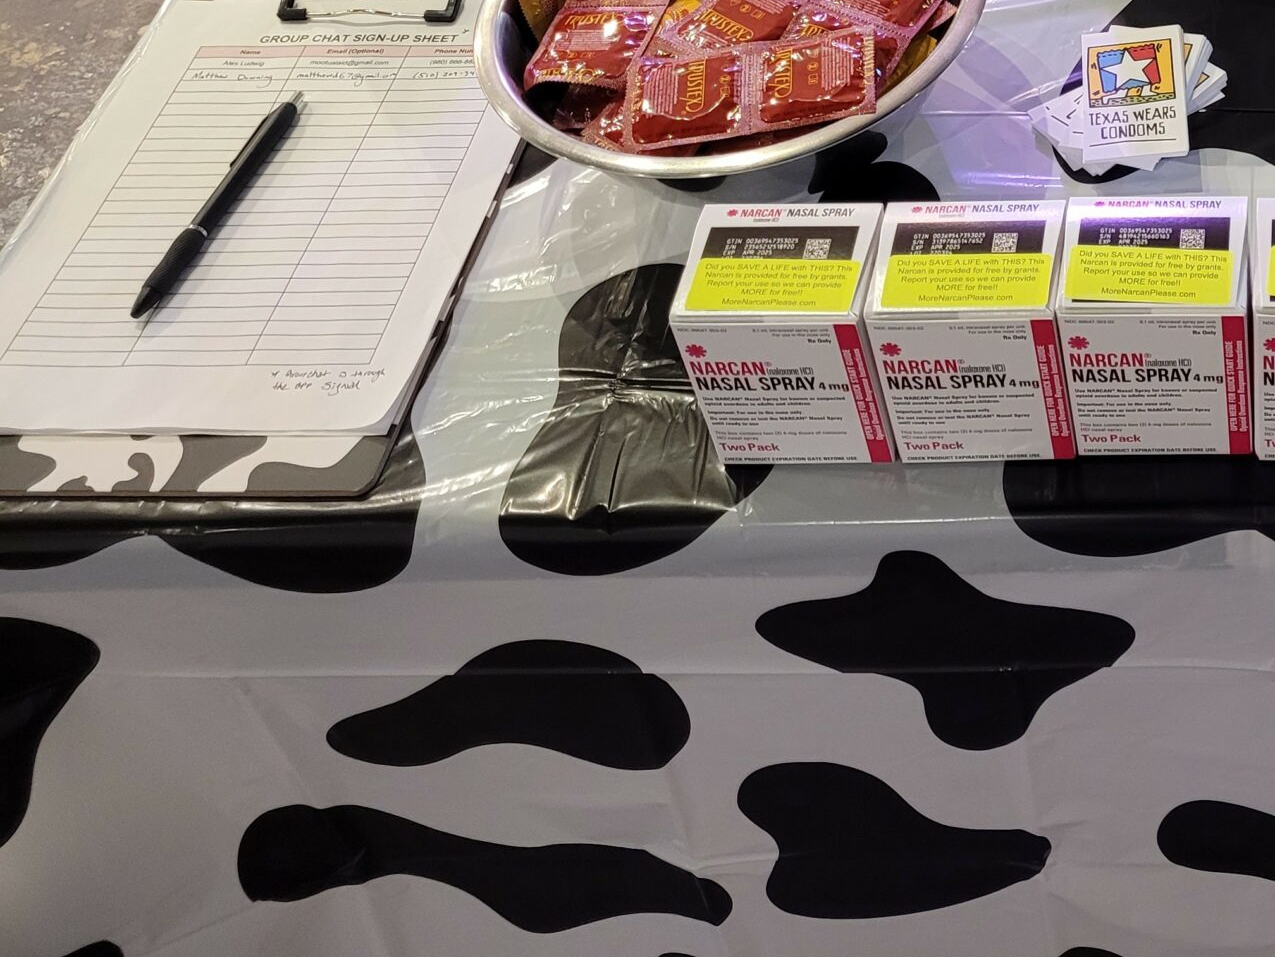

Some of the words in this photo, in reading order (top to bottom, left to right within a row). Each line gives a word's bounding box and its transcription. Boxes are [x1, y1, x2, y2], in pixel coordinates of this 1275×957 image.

[260, 34, 310, 44] GROUP
[312, 34, 350, 42] CHAT
[352, 34, 410, 42] SIGN-UP
[411, 34, 459, 42] SHEET
[239, 48, 262, 56] Name
[685, 59, 705, 115] TRUSTEX
[1088, 108, 1130, 126] TEXAS
[1133, 106, 1177, 124] WEARS
[1100, 123, 1166, 140] CONDOMS
[886, 376, 946, 389] NASAL
[949, 374, 1005, 388] SPRAY
[1072, 369, 1130, 382] NASAL
[1135, 368, 1190, 381] SPRAY
[695, 377, 756, 390] NASAL
[758, 376, 814, 390] SPRAY
[1081, 433, 1107, 442] Two
[1109, 433, 1141, 442] Pack
[718, 442, 746, 451] Two
[746, 442, 780, 451] Pack
[903, 441, 930, 450] Two
[931, 440, 964, 450] Pack
